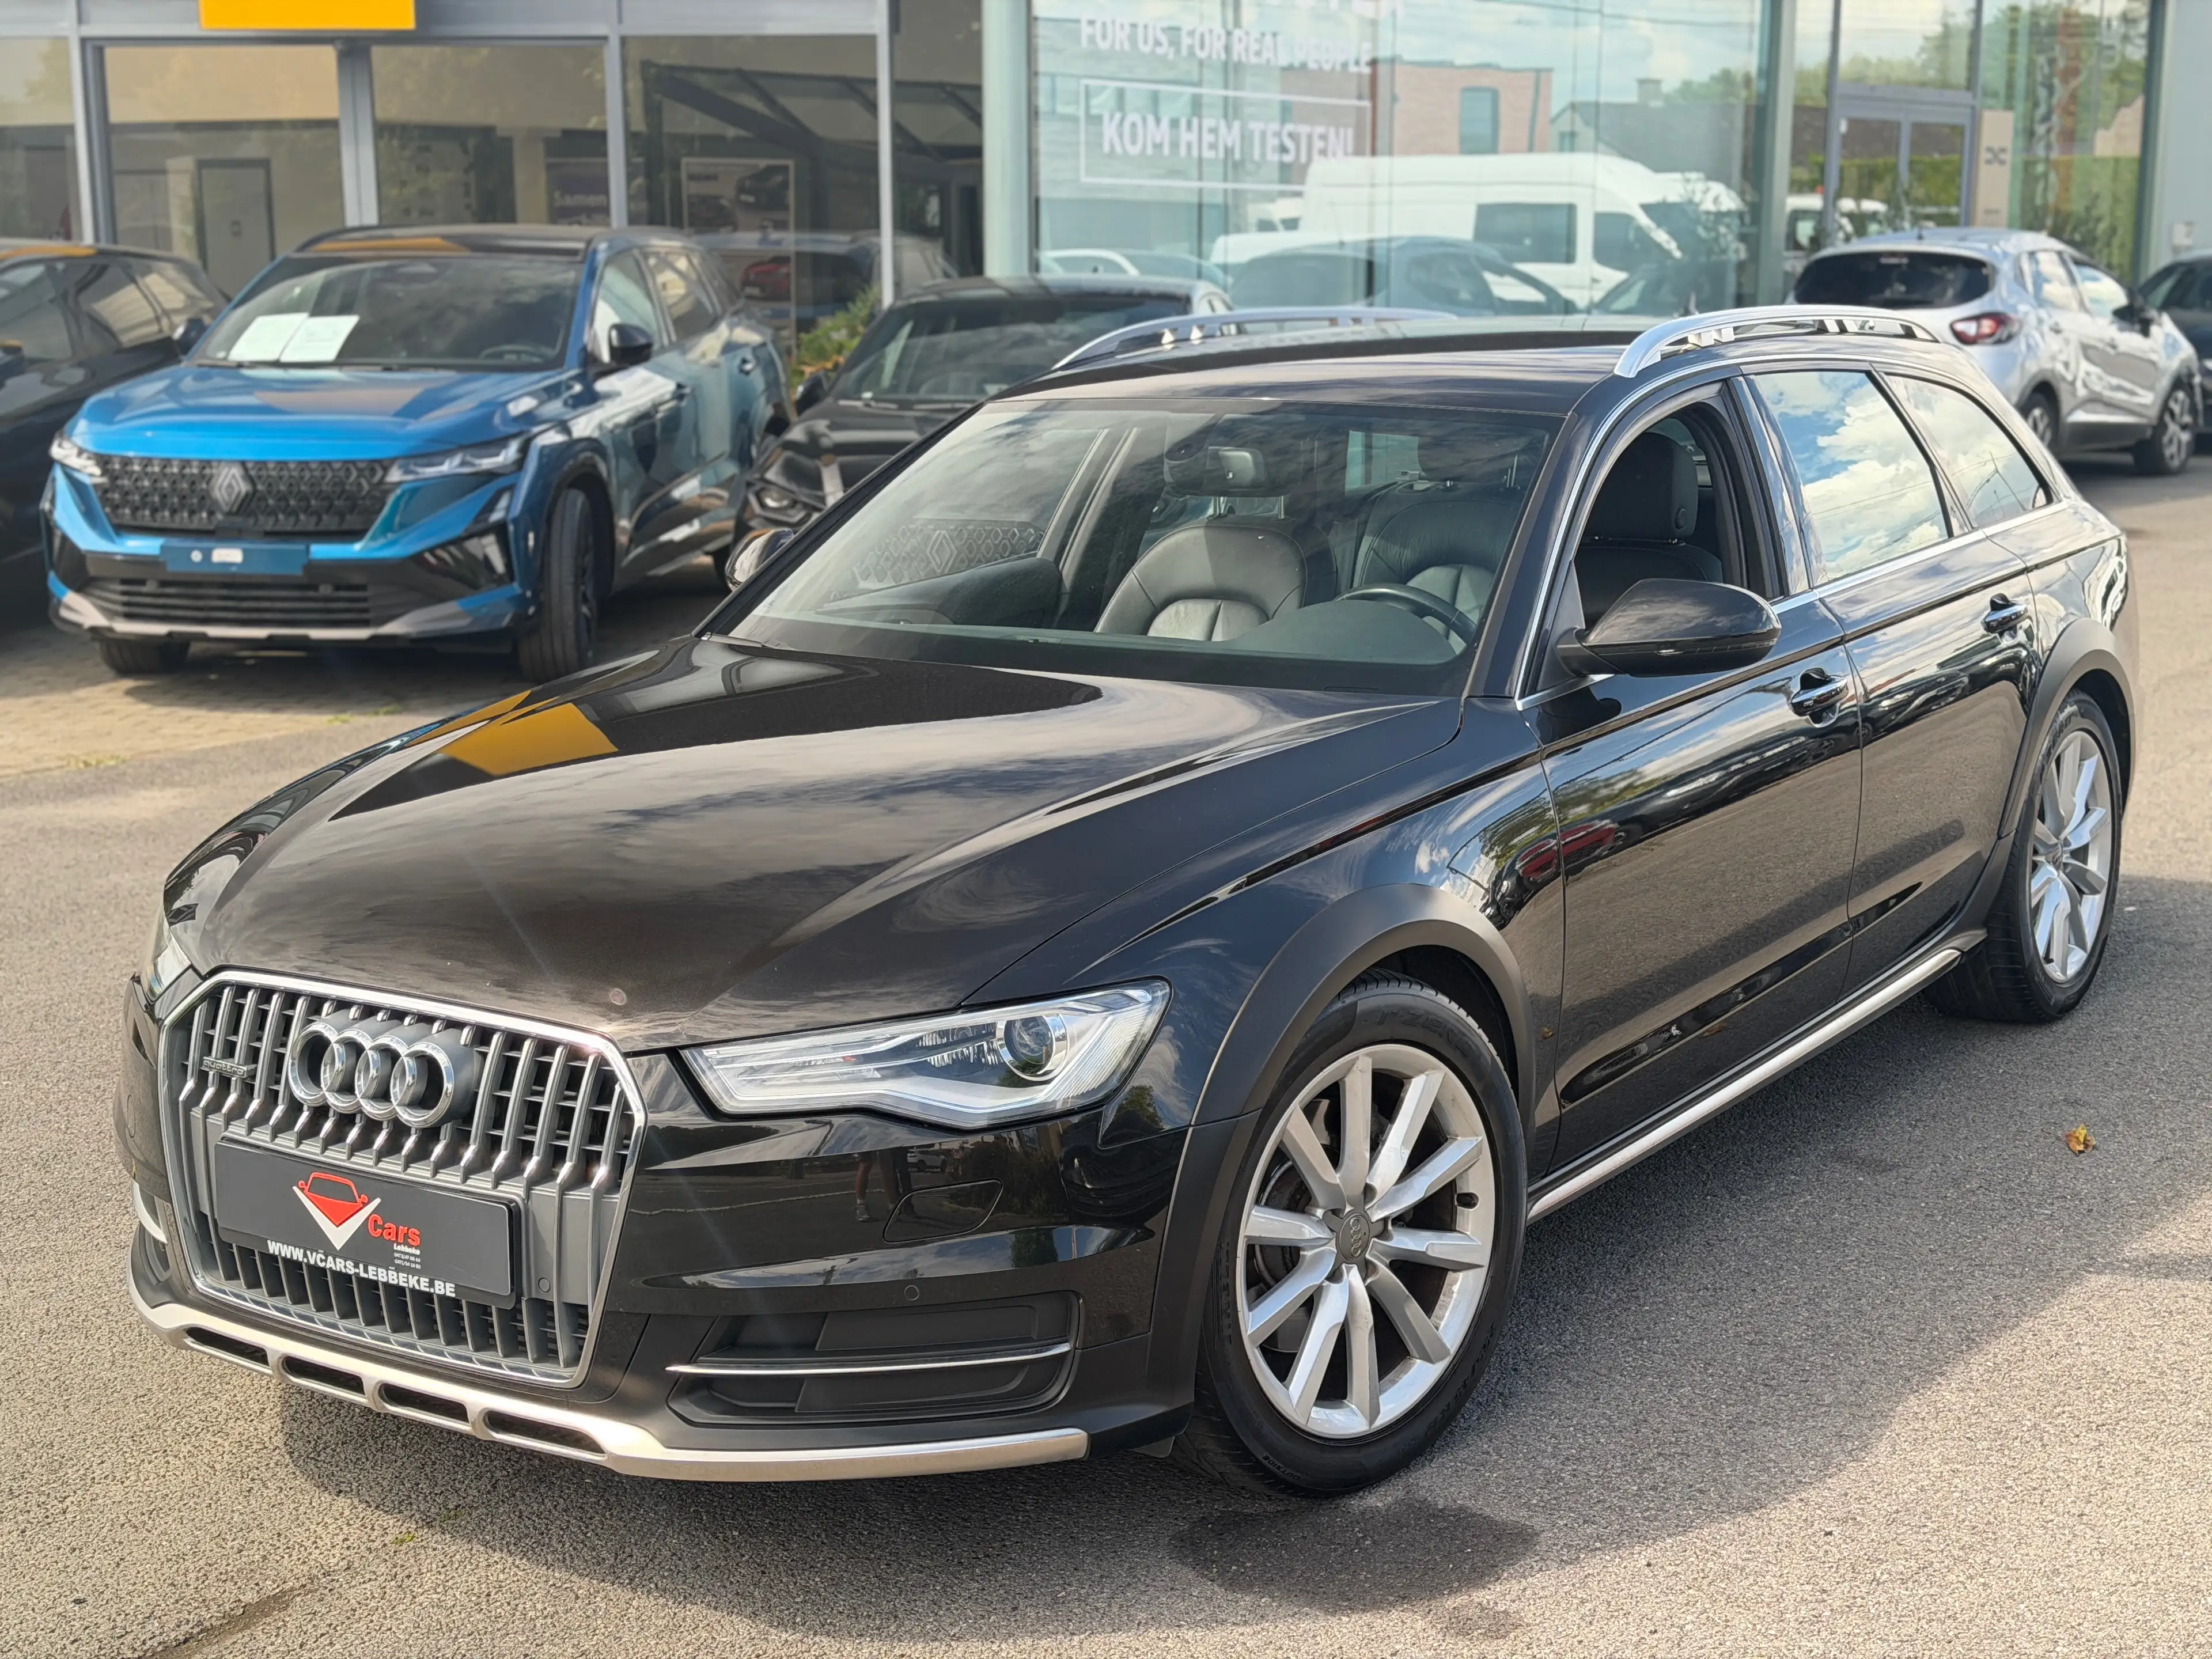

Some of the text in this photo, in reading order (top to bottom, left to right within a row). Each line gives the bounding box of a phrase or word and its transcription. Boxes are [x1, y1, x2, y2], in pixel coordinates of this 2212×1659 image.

[1081, 16, 1371, 74] FOR US, FOR REAL PEOPLE
[1101, 112, 1354, 164] KOM HEM TESTEN!
[203, 1060, 244, 1075] quattro
[368, 1214, 421, 1246] Cars
[267, 1239, 456, 1297] WWW.VCARS-LEBBEKE.BE
[1262, 1455, 1301, 1480] OUTSIDE
